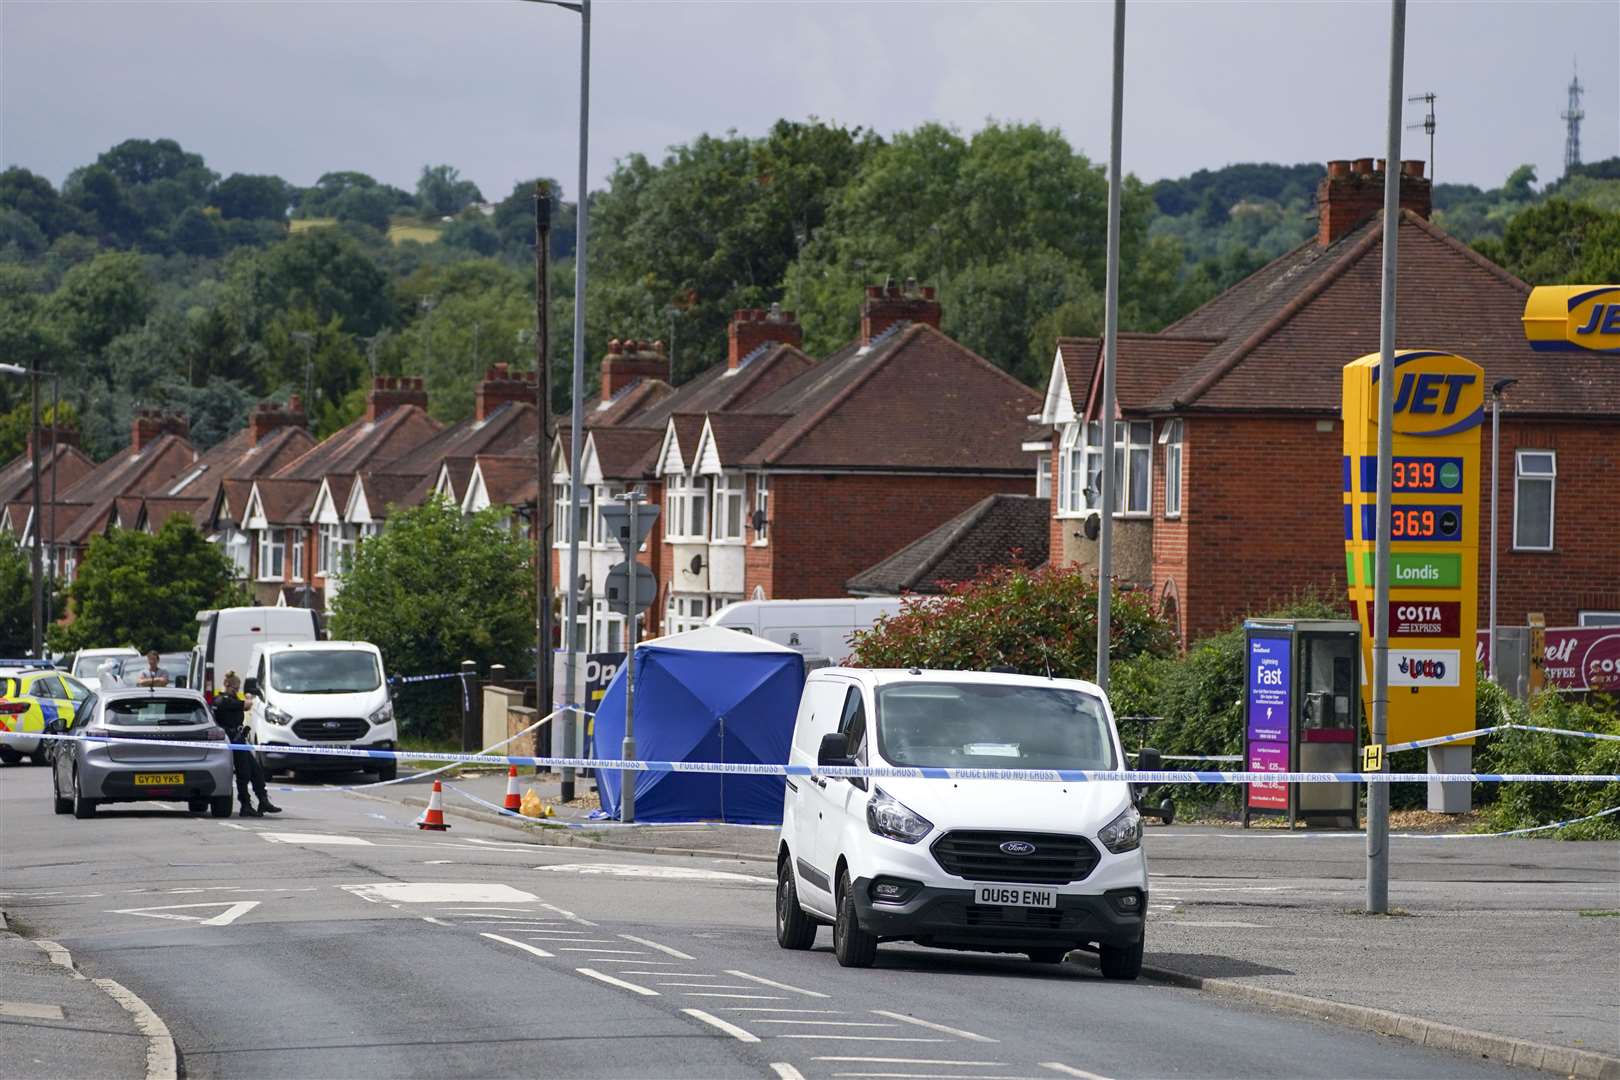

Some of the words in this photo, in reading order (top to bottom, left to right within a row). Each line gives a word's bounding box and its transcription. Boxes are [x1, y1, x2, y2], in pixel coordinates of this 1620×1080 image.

[1577, 303, 1620, 335] JE
[1392, 373, 1477, 415] JET
[1395, 564, 1440, 580] Londis
[1397, 606, 1442, 622] COSTA
[1410, 623, 1442, 633] EXPRESS
[1544, 638, 1578, 662] elf
[584, 660, 617, 686] Op
[1257, 665, 1282, 685] Fast
[1366, 746, 1380, 768] H
[754, 765, 778, 773] CROSS
[863, 768, 872, 776] DO
[875, 768, 890, 776] NOT
[892, 768, 916, 777] CROSS
[955, 770, 981, 778] POLICE
[983, 770, 999, 778] LINE
[1001, 771, 1010, 779] DO
[1012, 771, 1027, 779] NOT
[1029, 771, 1054, 780] CROSS
[1094, 773, 1119, 781] POLICE
[1121, 773, 1137, 781] LINE
[1139, 773, 1149, 781] DO
[1151, 773, 1165, 781] NOT
[1168, 773, 1192, 781] CROSS
[138, 775, 161, 784] GY70
[163, 775, 180, 784] YKS
[1007, 843, 1028, 853] Ford
[982, 888, 1019, 904] OU69
[1022, 890, 1050, 906] ENH
